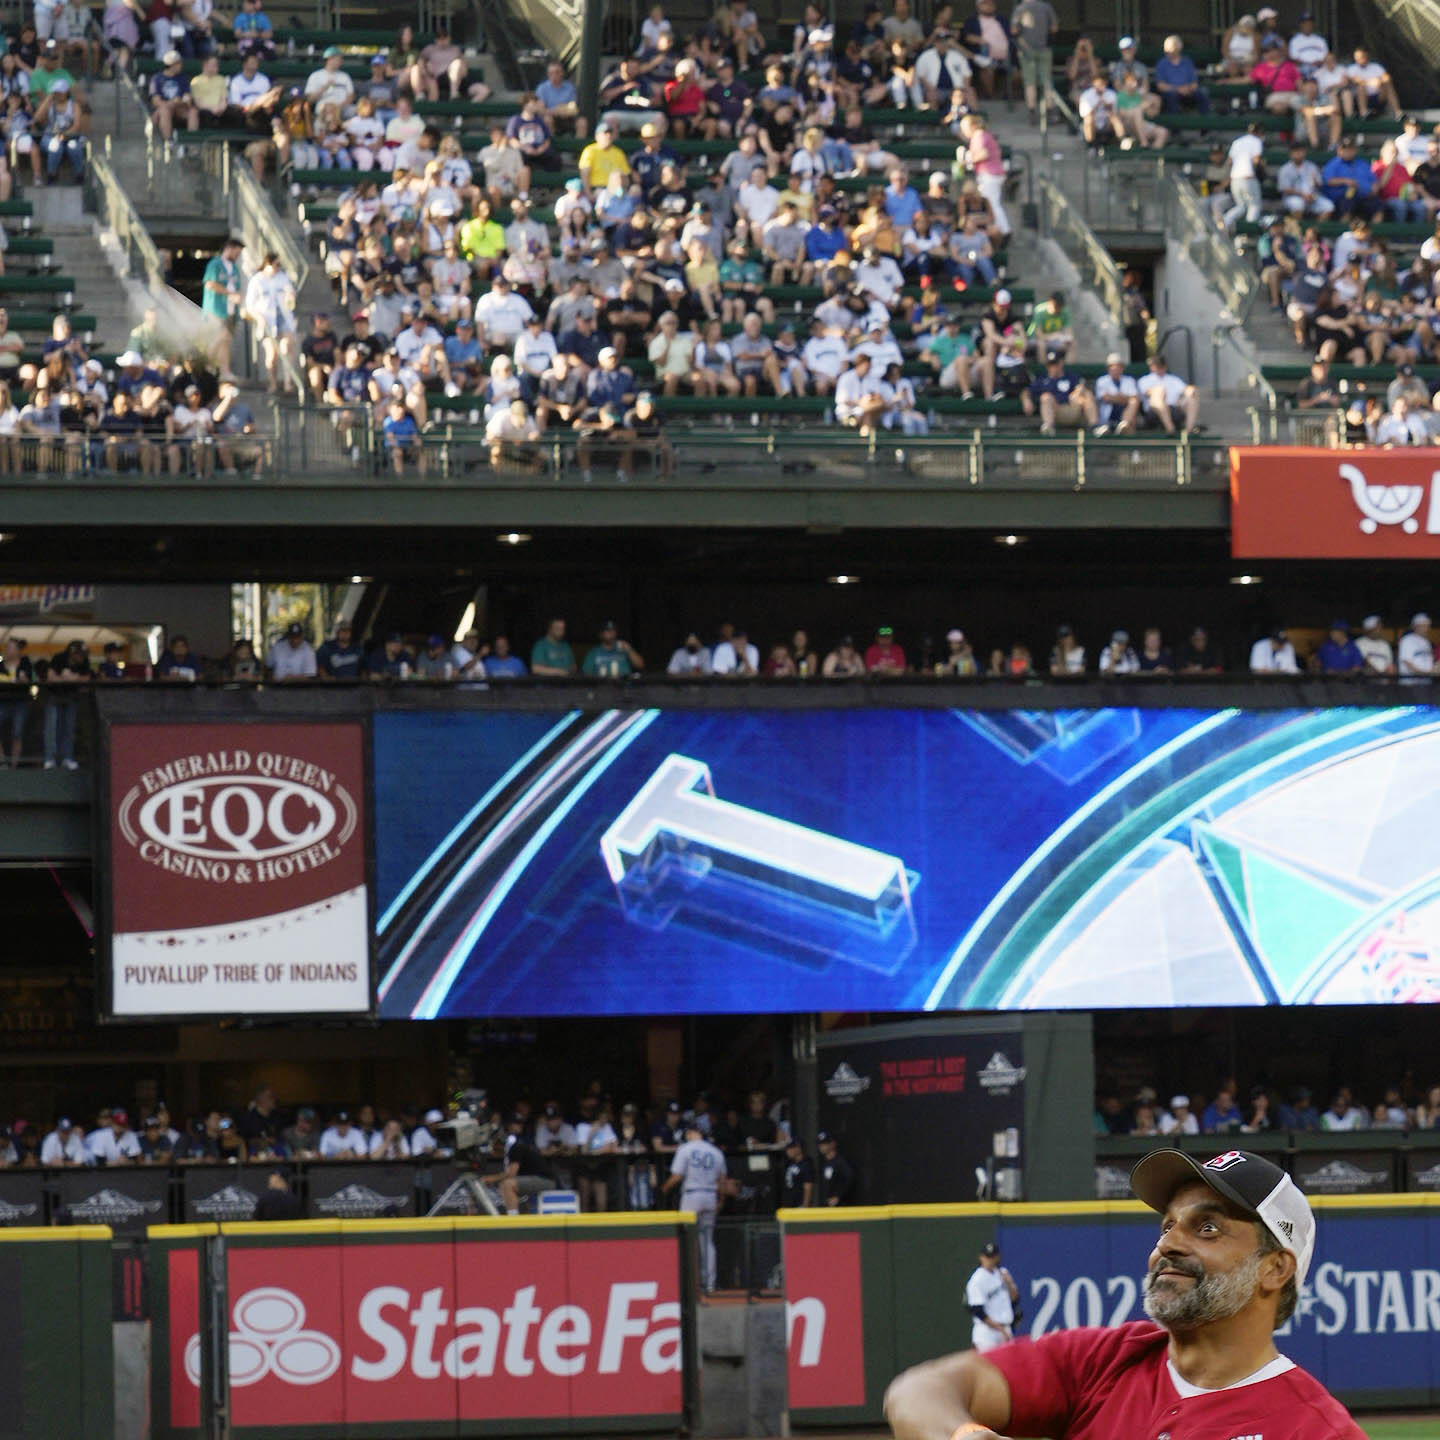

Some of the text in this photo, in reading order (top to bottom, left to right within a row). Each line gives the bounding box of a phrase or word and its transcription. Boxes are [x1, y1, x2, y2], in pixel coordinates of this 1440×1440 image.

[140, 750, 336, 794] EMERALD QUEEN
[166, 785, 316, 858] EQC
[139, 840, 341, 884] CASINO & HOTEL
[124, 962, 358, 984] PUYALLUP TRIBE OF INDIANS
